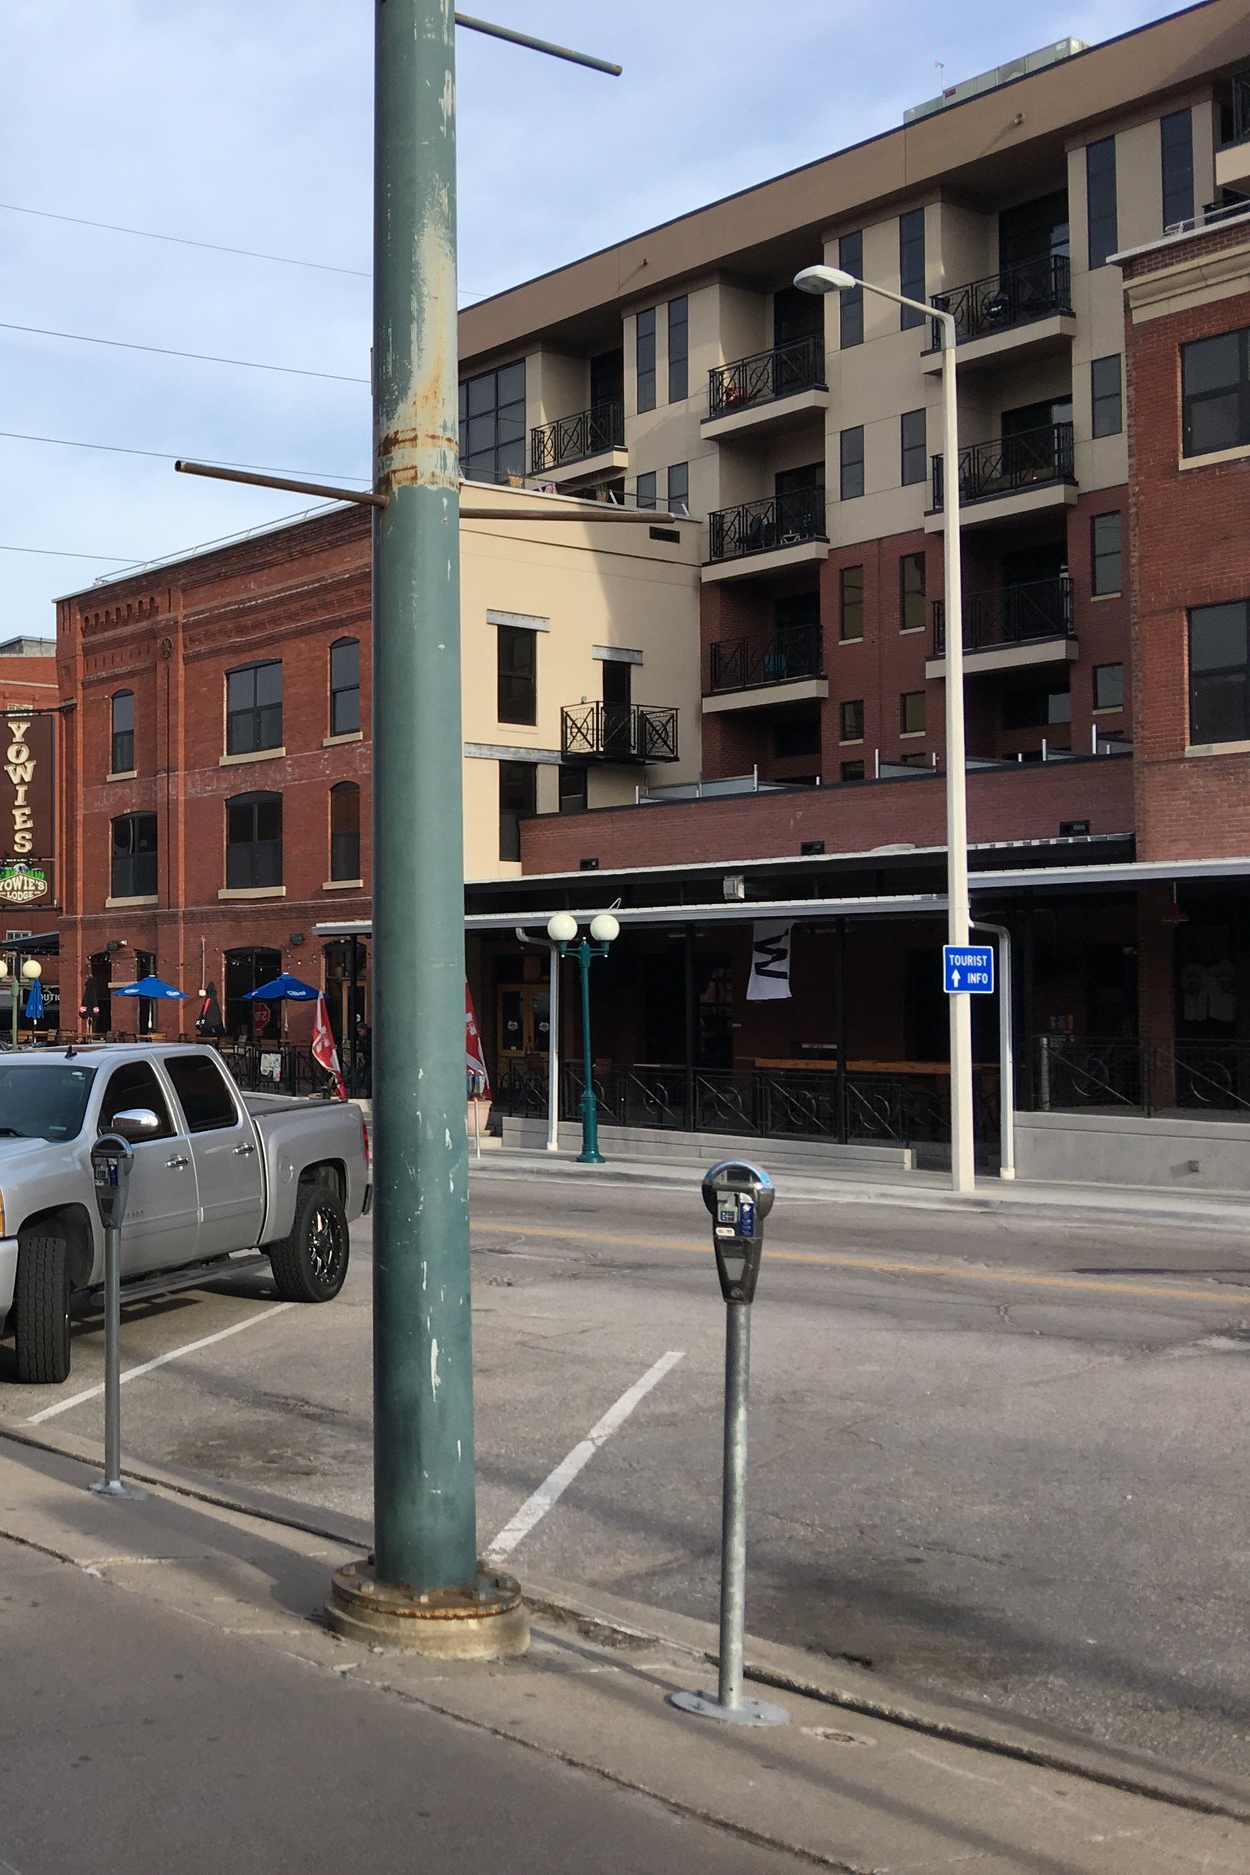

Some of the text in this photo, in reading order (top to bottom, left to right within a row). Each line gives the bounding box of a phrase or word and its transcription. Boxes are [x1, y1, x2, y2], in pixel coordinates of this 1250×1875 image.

[4, 721, 37, 853] YOWIES
[6, 890, 34, 899] LODGE
[948, 954, 988, 967] TOURIST
[968, 972, 988, 984] INFO
